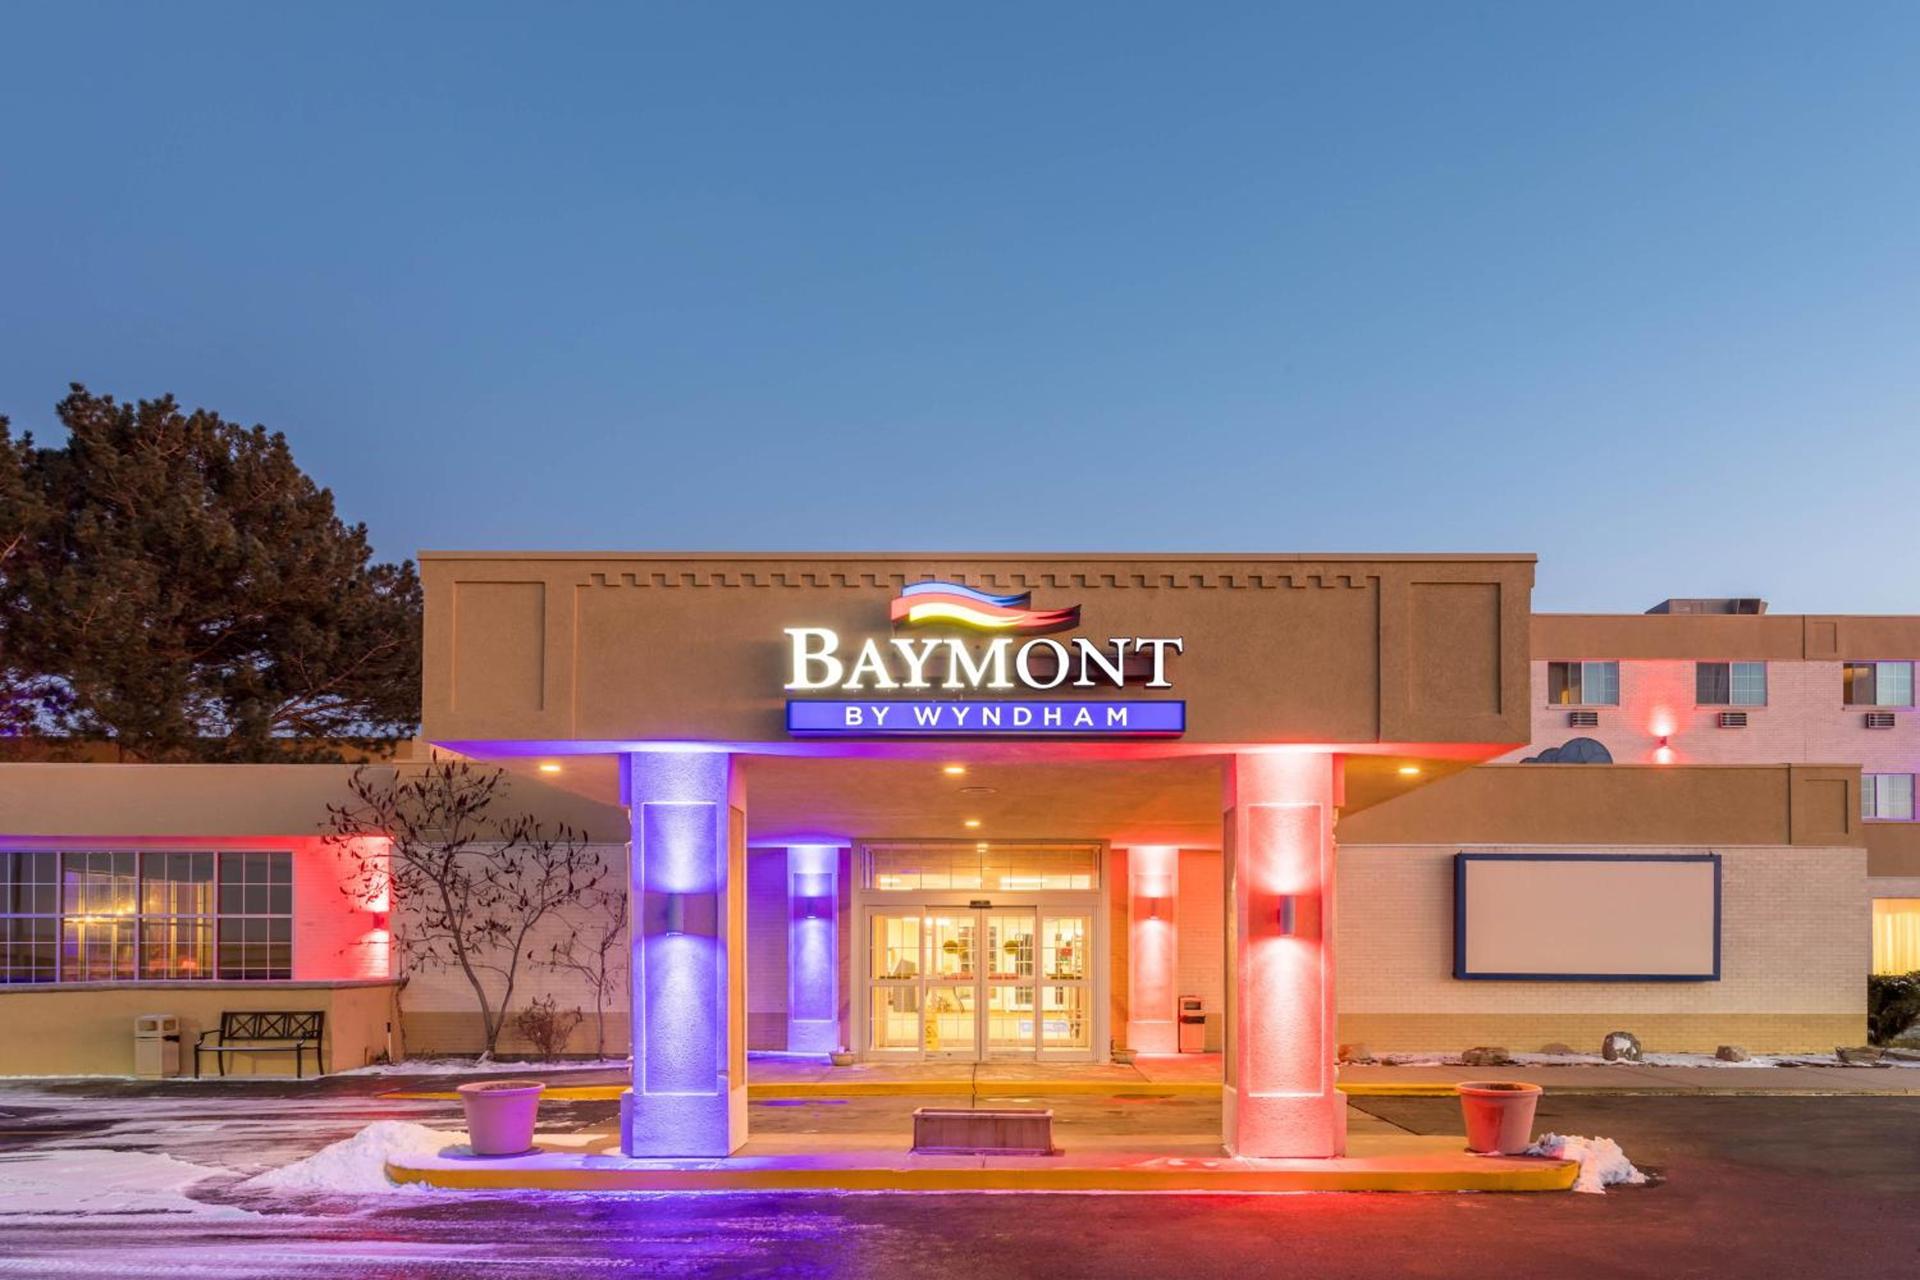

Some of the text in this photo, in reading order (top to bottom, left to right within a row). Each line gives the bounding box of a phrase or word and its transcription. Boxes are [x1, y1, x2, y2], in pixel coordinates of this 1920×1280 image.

[783, 627, 1184, 690] BAYMONT
[845, 706, 1129, 727] BY WYNDHAM
